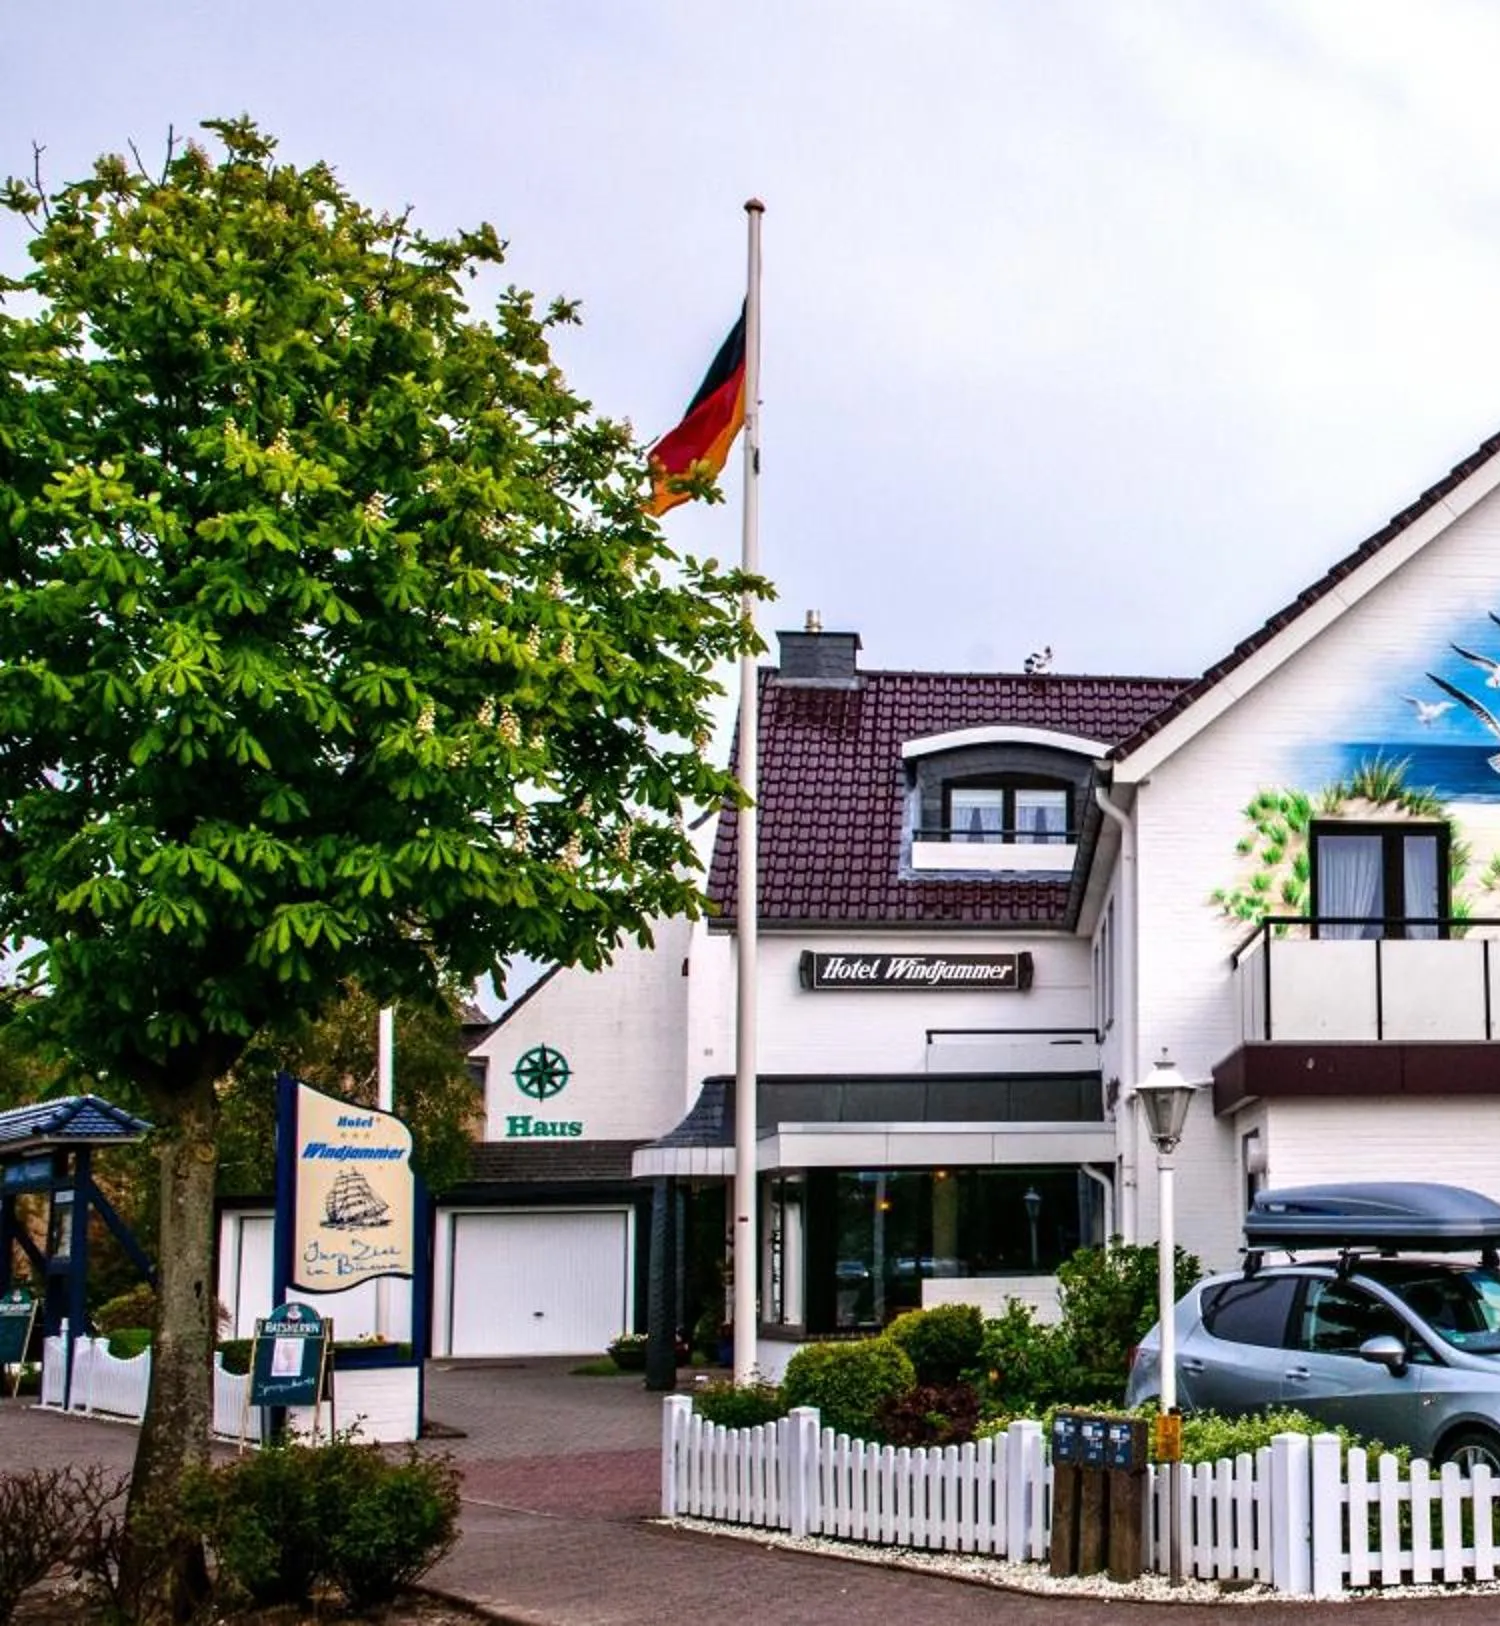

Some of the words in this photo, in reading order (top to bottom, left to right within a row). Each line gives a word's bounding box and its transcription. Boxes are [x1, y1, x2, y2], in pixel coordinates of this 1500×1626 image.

[821, 957, 880, 979] Hotel
[884, 957, 1013, 985] Windjammer
[337, 1115, 374, 1128] Hotel
[506, 1115, 583, 1137] Haus
[302, 1142, 407, 1161] Windjammer
